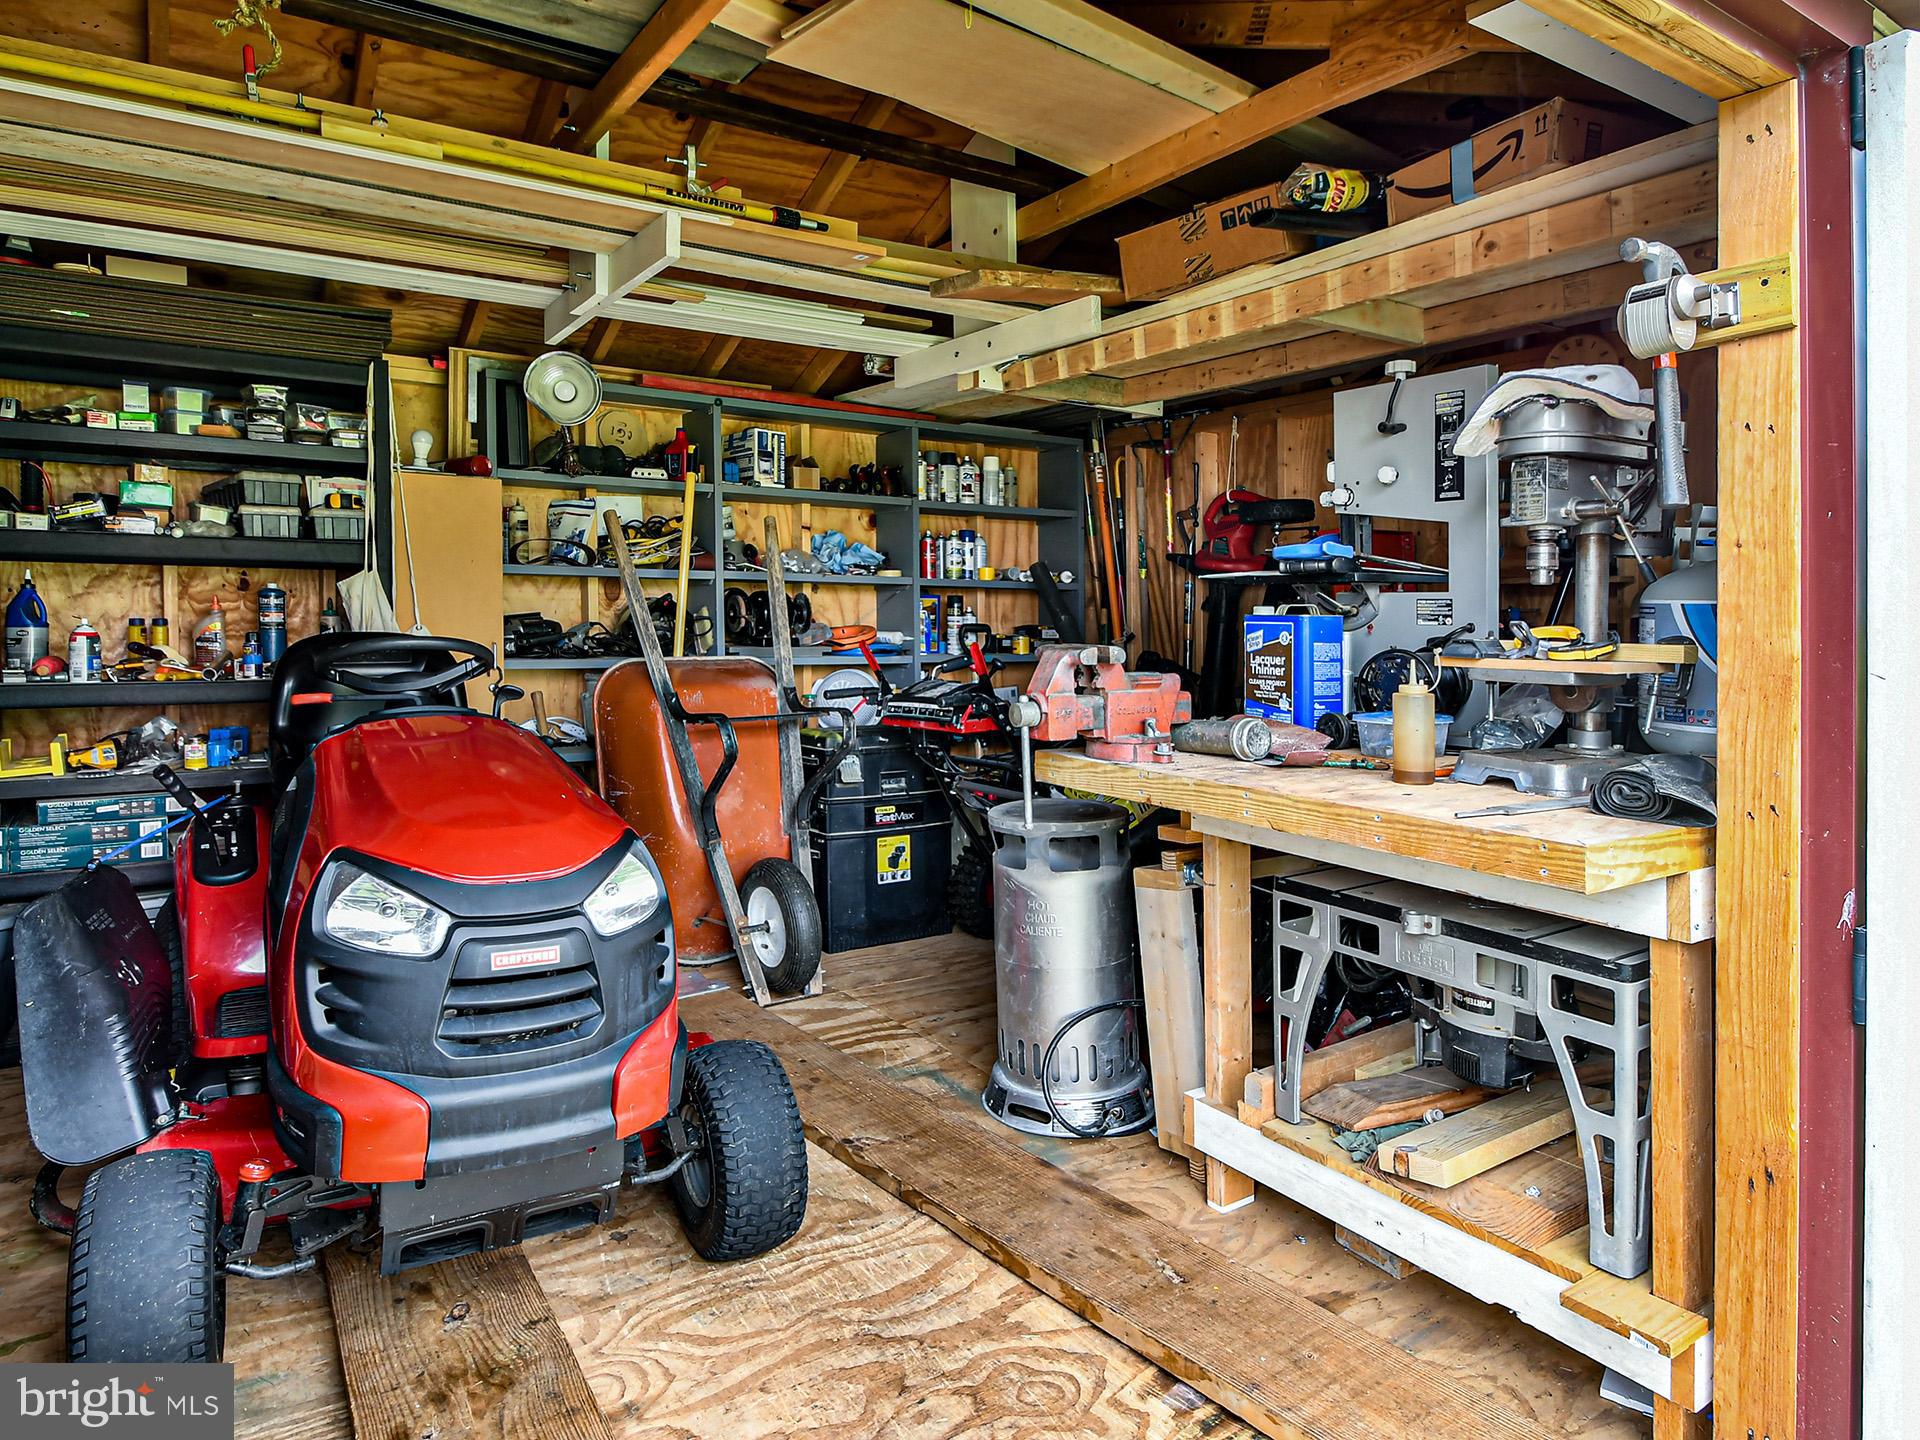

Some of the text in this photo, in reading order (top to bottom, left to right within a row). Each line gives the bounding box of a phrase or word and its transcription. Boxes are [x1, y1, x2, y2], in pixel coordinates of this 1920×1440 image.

[1250, 653, 1286, 667] Lacquer
[1250, 664, 1286, 676] Thinner
[1027, 900, 1050, 911] HOT
[1025, 912, 1058, 924] CHAUD
[1020, 924, 1063, 937] CALIENTE
[495, 950, 556, 966] CRAFTSMAN
